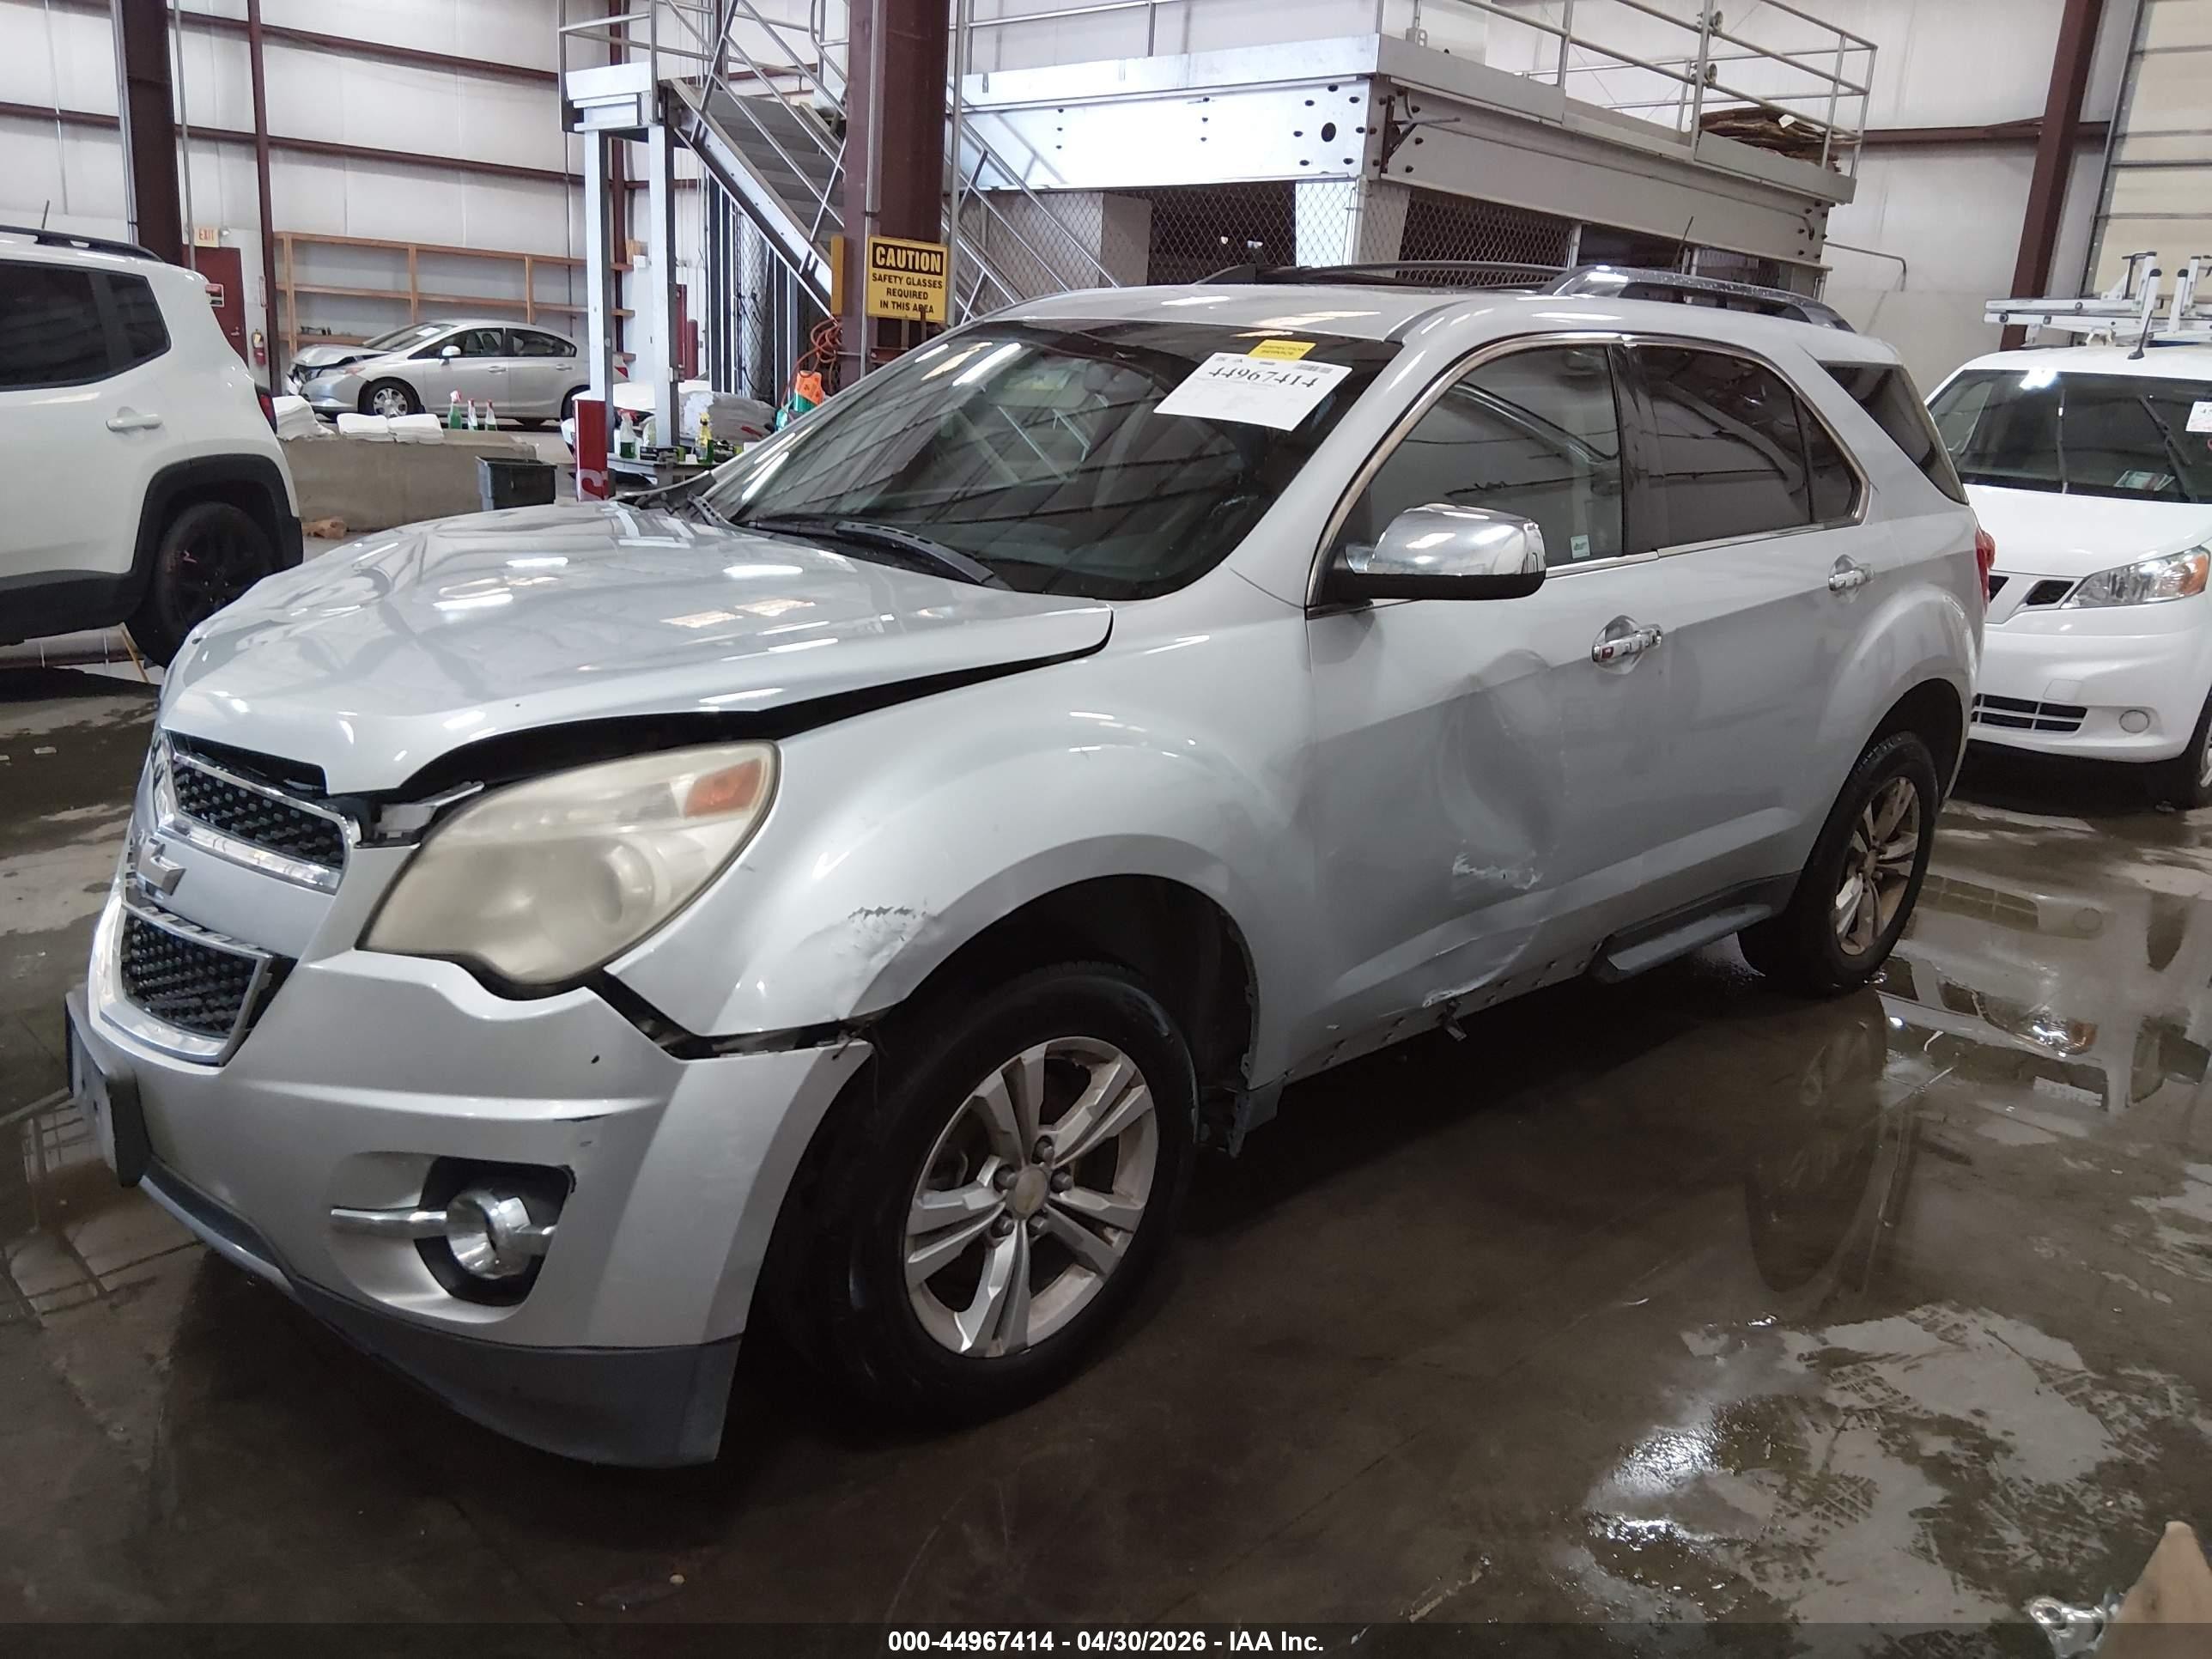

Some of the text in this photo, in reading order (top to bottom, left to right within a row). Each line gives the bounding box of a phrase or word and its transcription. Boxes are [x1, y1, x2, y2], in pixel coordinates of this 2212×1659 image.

[875, 246, 941, 273] CAUTION
[872, 273, 943, 289] SAFETY GLASSES
[886, 288, 928, 300] REQUIRED
[880, 300, 889, 309] IN
[891, 301, 910, 311] THIS
[1208, 367, 1319, 387] 44967414
